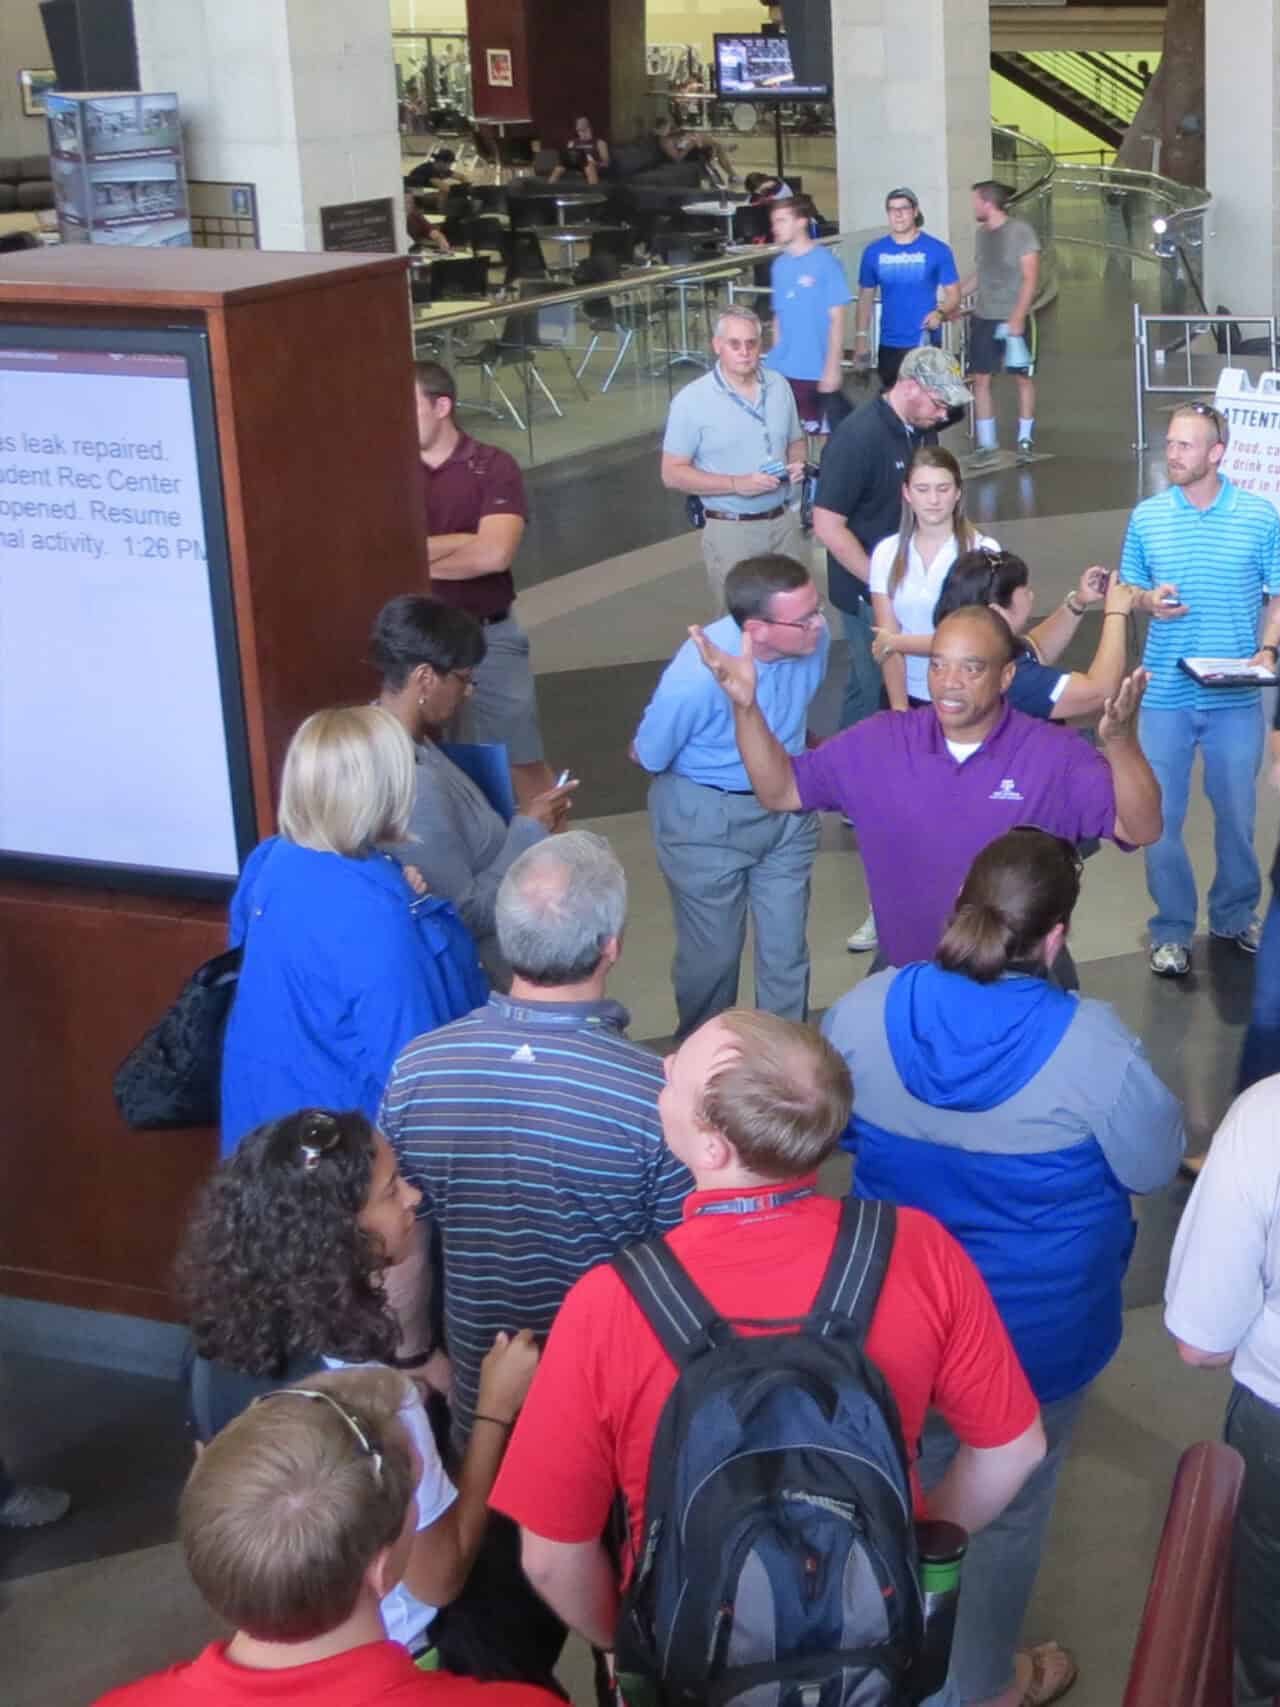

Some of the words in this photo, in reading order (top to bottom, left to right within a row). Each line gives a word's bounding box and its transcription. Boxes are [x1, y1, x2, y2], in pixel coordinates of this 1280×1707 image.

[22, 432, 66, 455] leak
[72, 437, 168, 462] repaired.
[1232, 459, 1262, 472] drink
[58, 466, 102, 489] Rec
[107, 469, 182, 494] Center
[90, 500, 181, 526] Resume
[31, 531, 110, 559] activity.
[123, 535, 170, 559] 1:26
